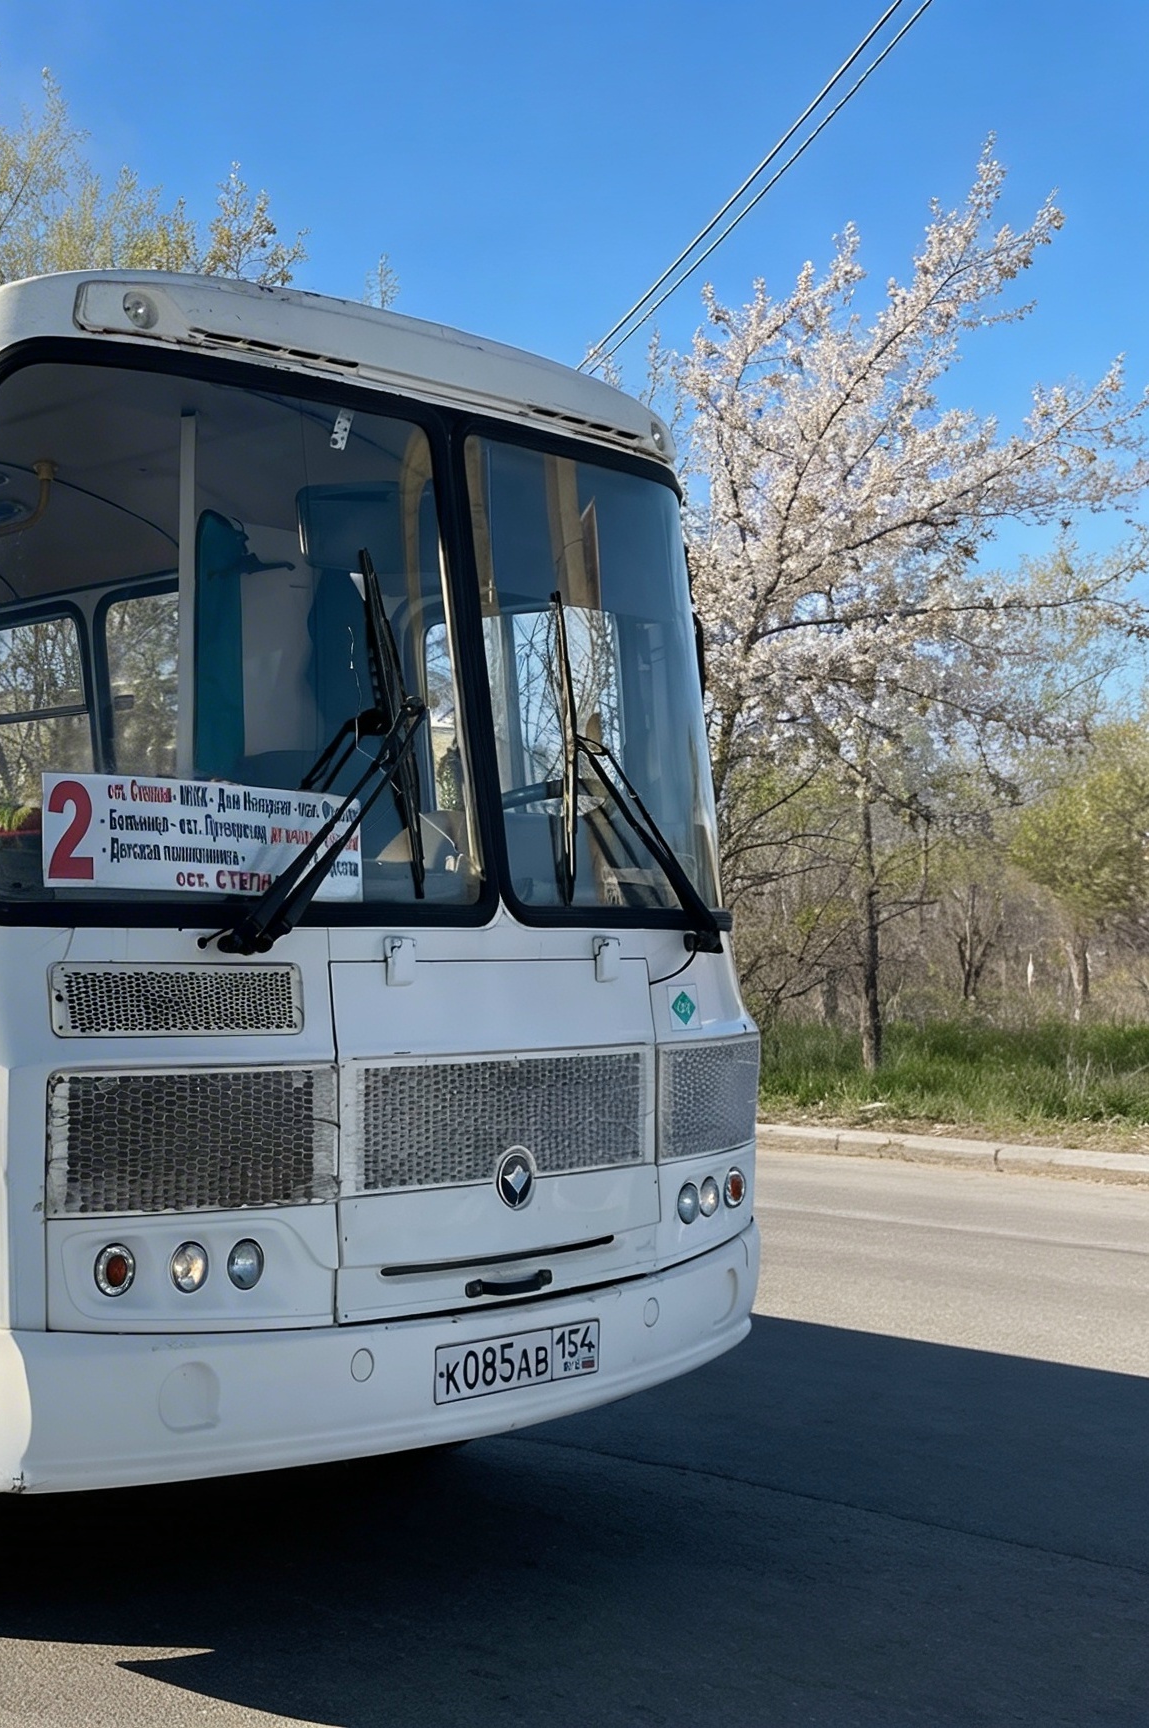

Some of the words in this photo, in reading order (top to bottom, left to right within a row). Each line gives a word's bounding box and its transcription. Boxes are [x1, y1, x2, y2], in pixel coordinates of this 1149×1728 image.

[48, 780, 94, 880] 2
[216, 870, 280, 892] СТЕПН
[446, 1342, 549, 1395] К085АВ
[555, 1325, 595, 1359] 154
